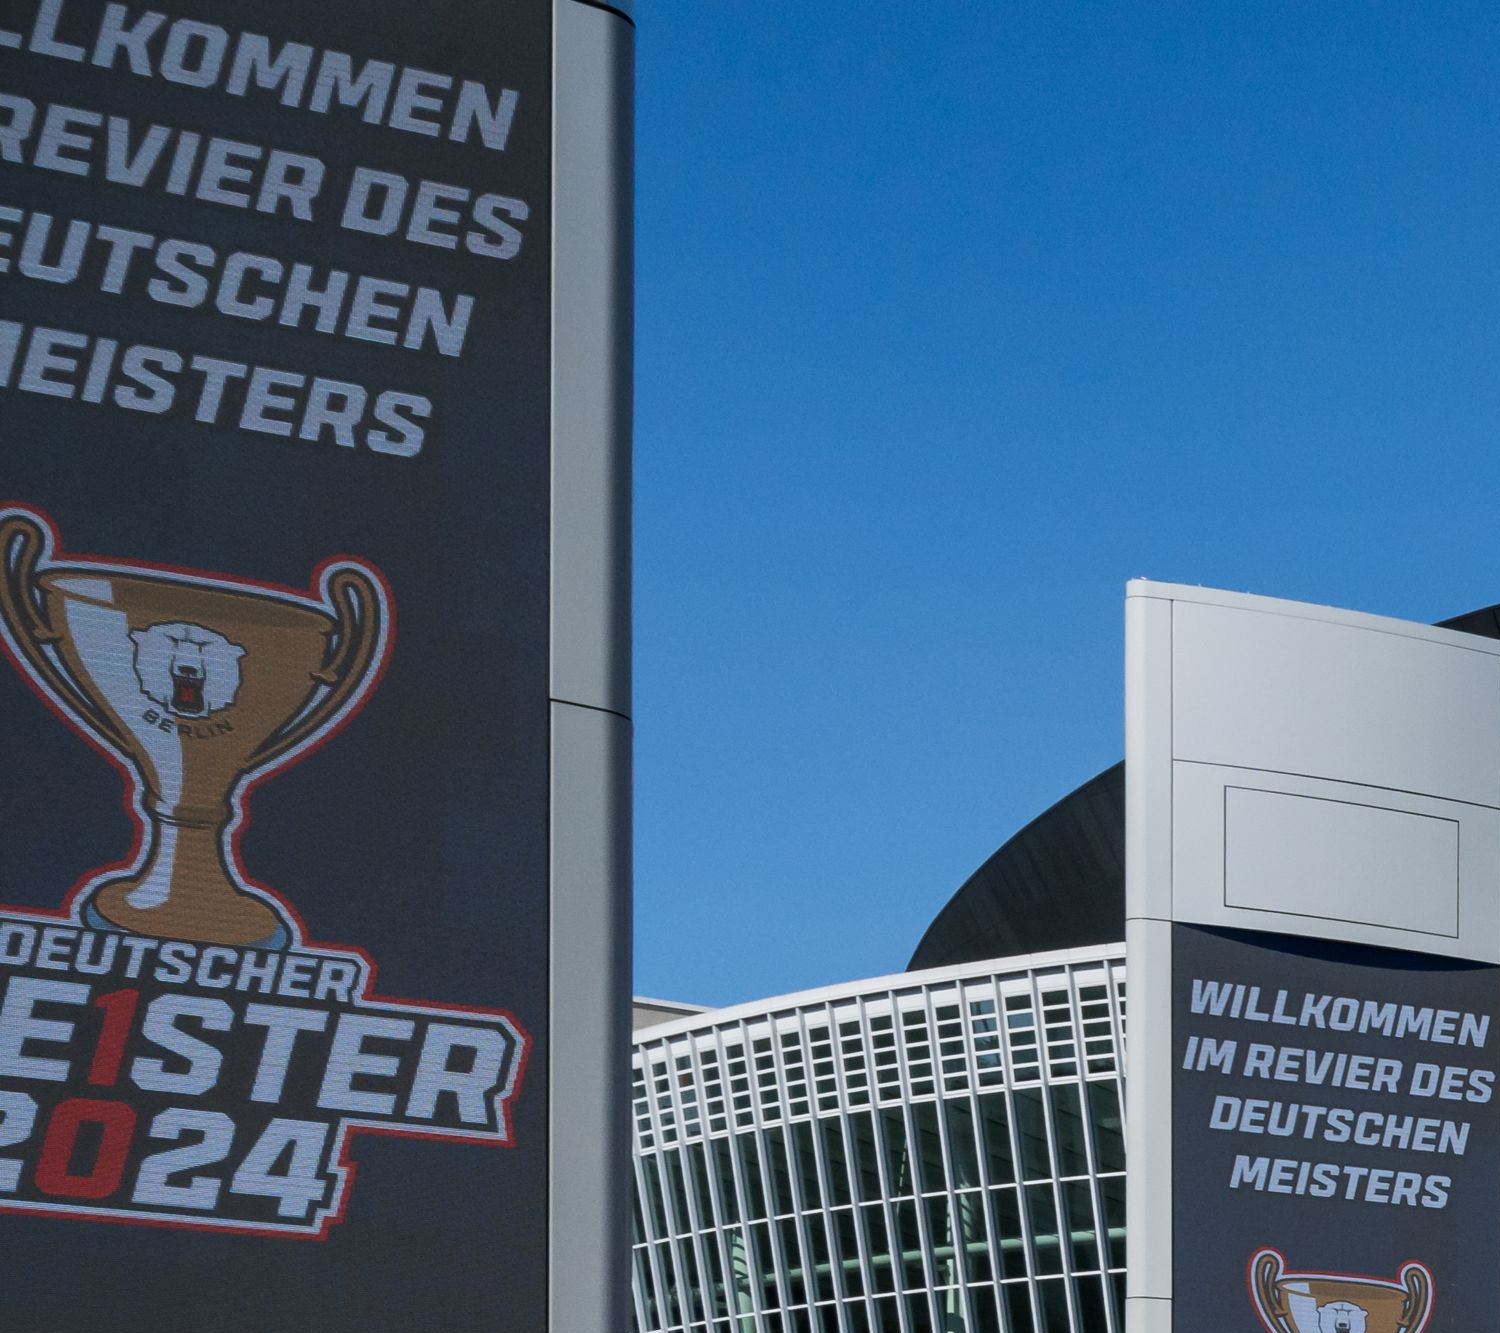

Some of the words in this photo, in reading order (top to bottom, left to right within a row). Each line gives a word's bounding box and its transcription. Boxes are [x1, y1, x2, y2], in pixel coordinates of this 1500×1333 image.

[0, 0, 518, 150] LKOMMEN
[341, 166, 530, 260] DES
[142, 707, 234, 738] BERLIN
[2, 921, 361, 1003] DEUTSCHER
[1191, 979, 1490, 1049] WILLKOMMEN
[1182, 1036, 1237, 1075] IM
[1243, 1043, 1402, 1095] REVIER
[1411, 1064, 1496, 1104] DES
[1209, 1095, 1472, 1156] DEUTSCHEN
[1229, 1154, 1453, 1210] MEISTERS
